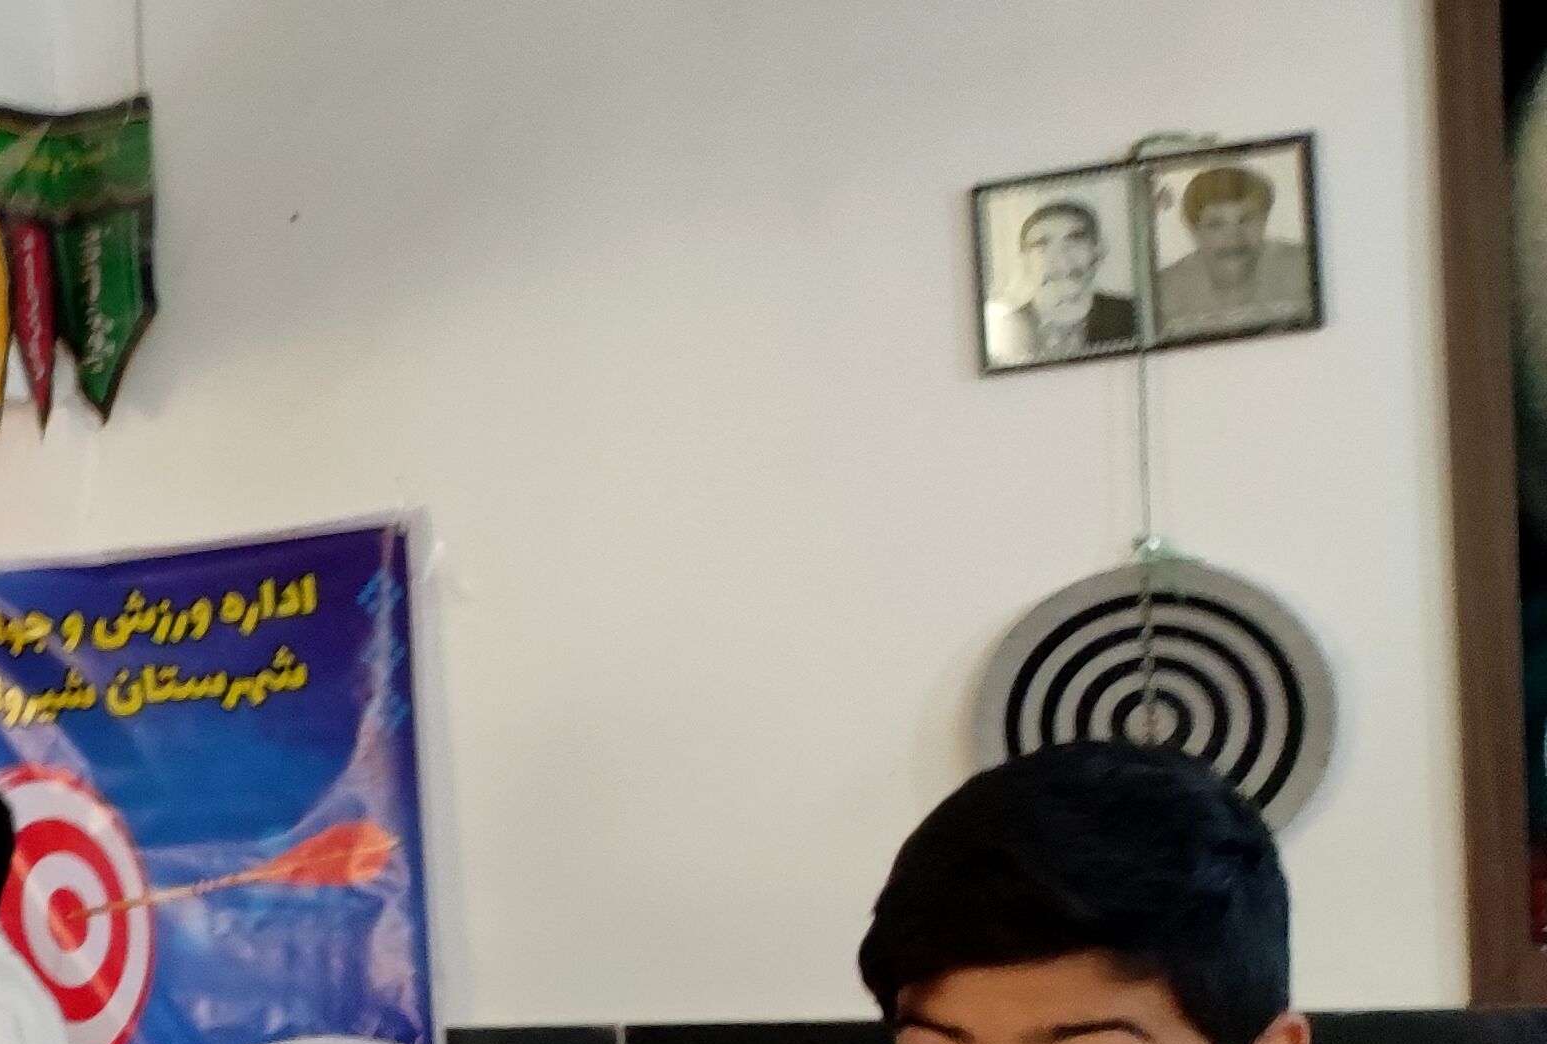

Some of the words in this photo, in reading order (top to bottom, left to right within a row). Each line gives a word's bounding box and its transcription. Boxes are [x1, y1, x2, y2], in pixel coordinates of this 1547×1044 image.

[60, 609, 85, 654] و
[92, 588, 212, 652] ورزش
[220, 572, 318, 637] اداره
[105, 644, 308, 718] شهرستان
